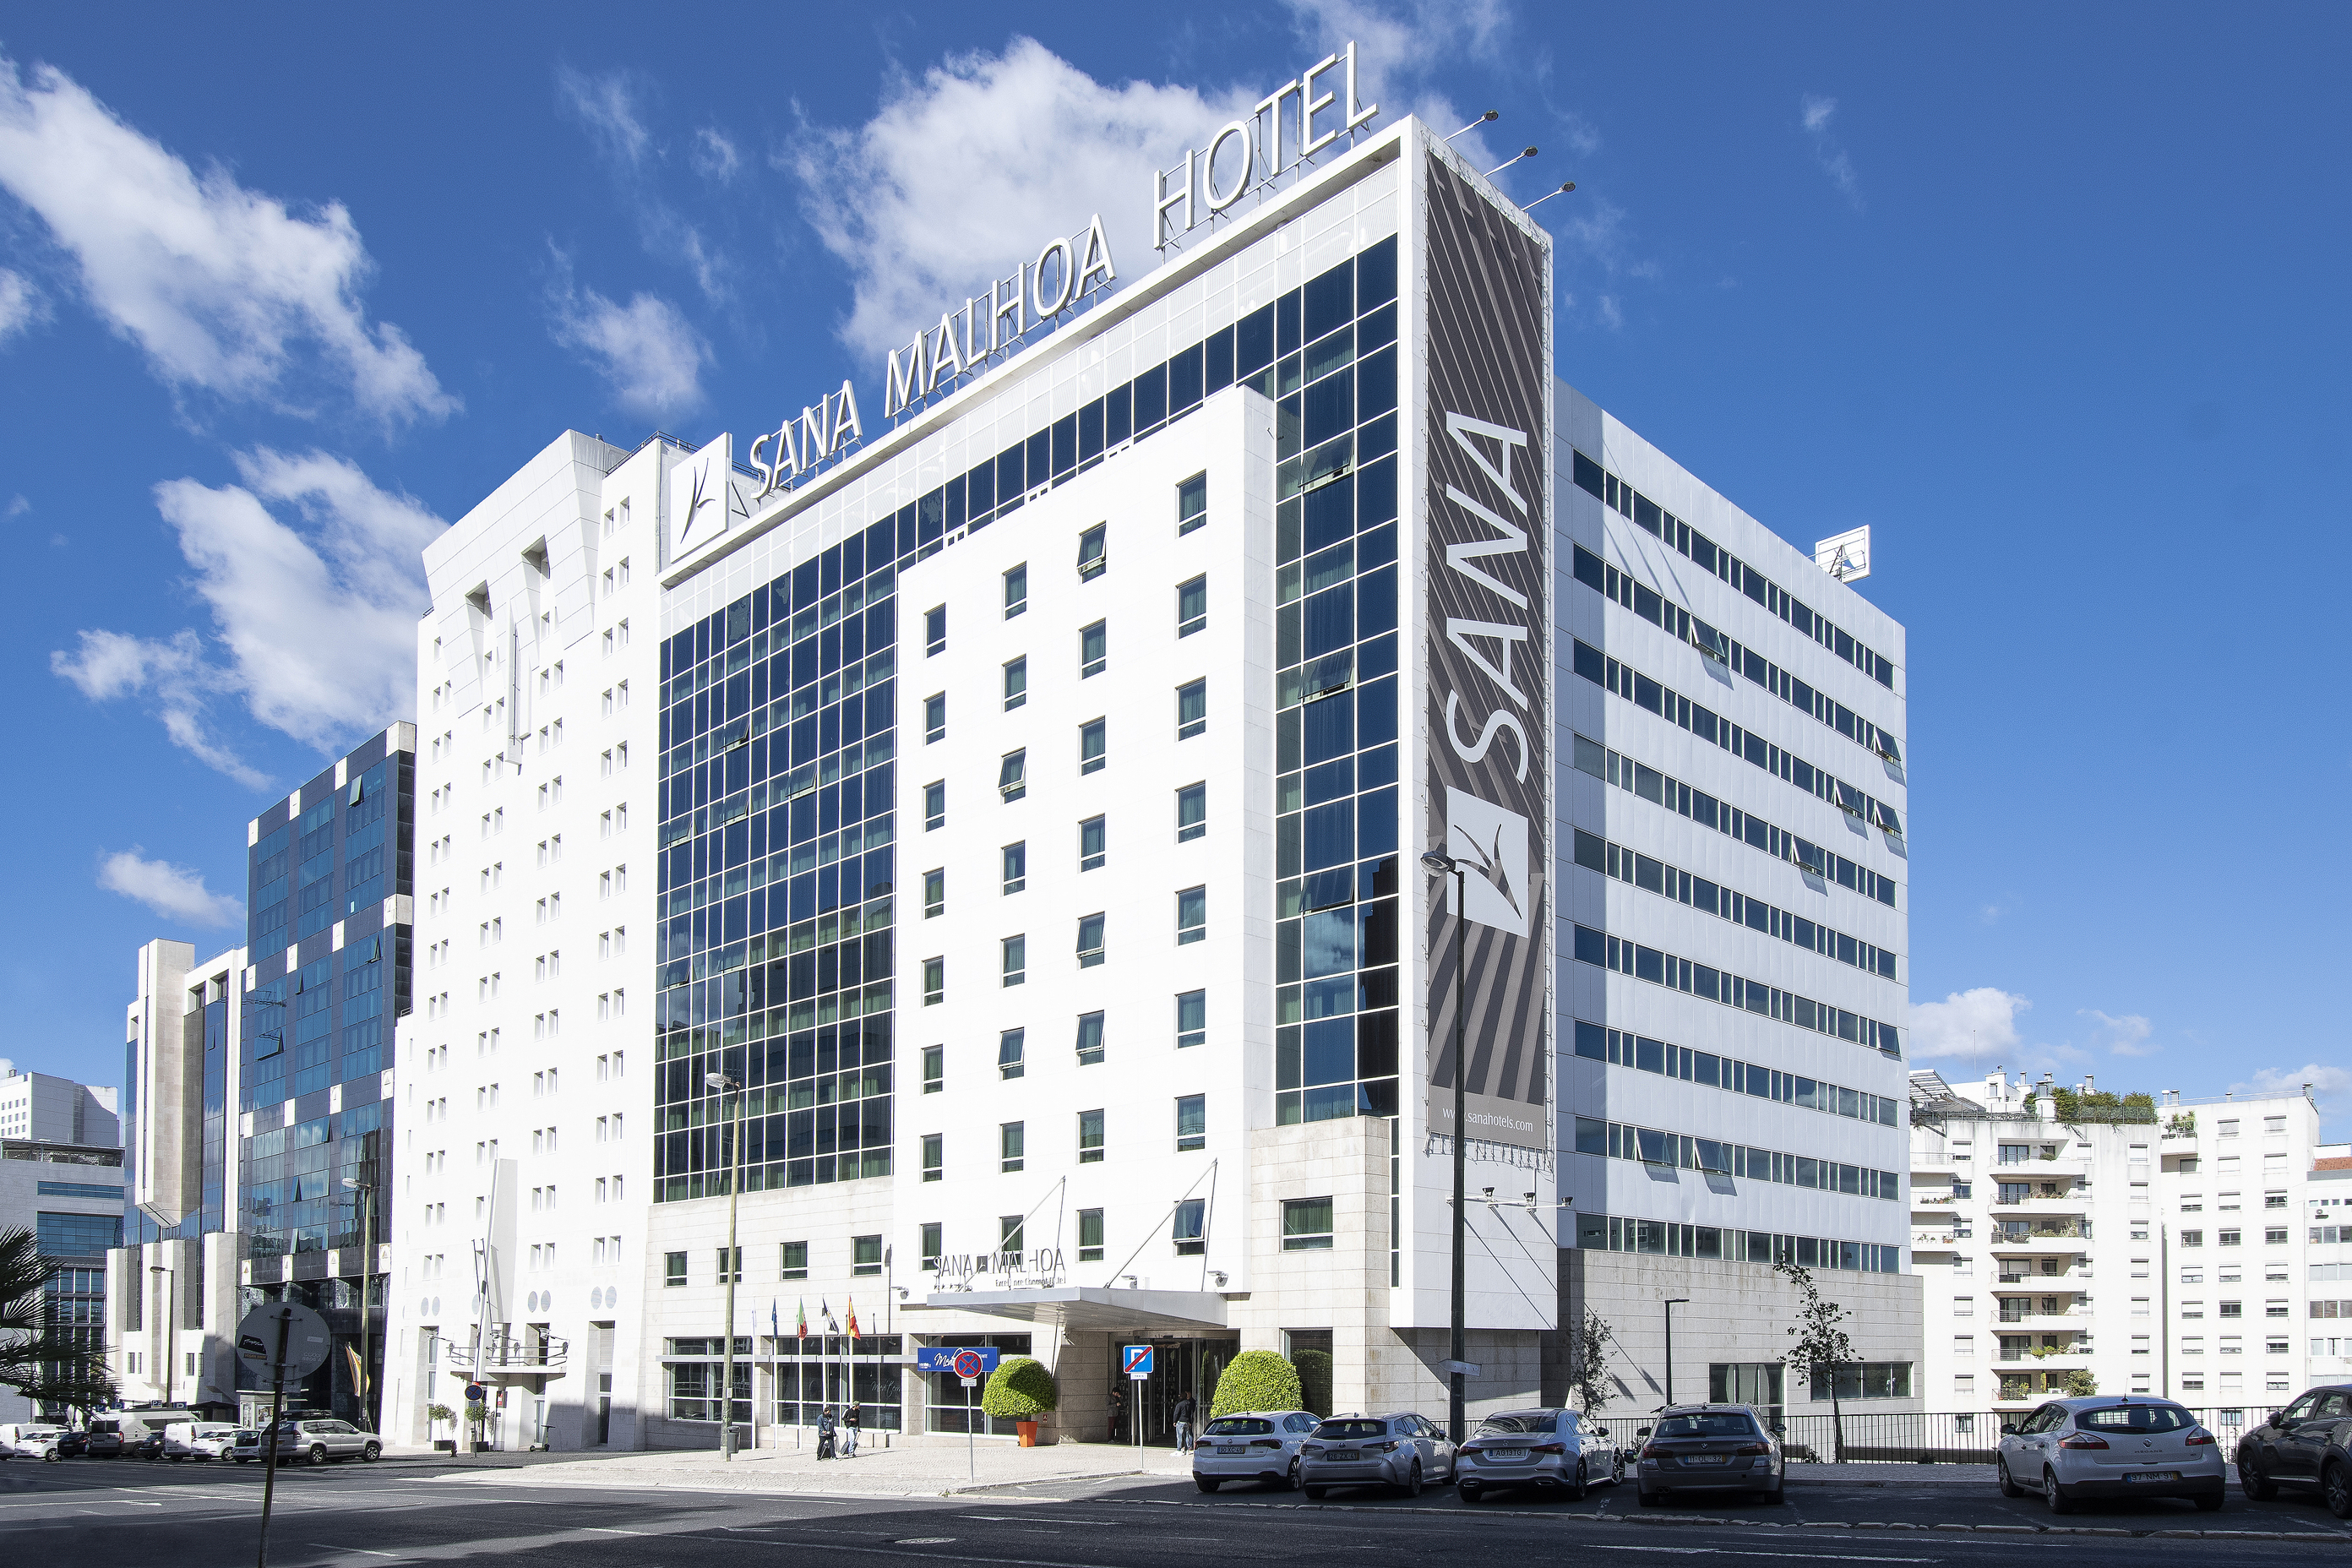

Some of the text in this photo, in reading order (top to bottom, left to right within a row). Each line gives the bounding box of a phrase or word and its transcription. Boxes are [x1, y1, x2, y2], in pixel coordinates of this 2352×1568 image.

[750, 41, 1380, 500] SANA MALHOA HOTEL
[1446, 411, 1528, 785] SANA
[1442, 1108, 1533, 1132] ww.sanahotels.com
[934, 1248, 1065, 1277] SANA MALHOA
